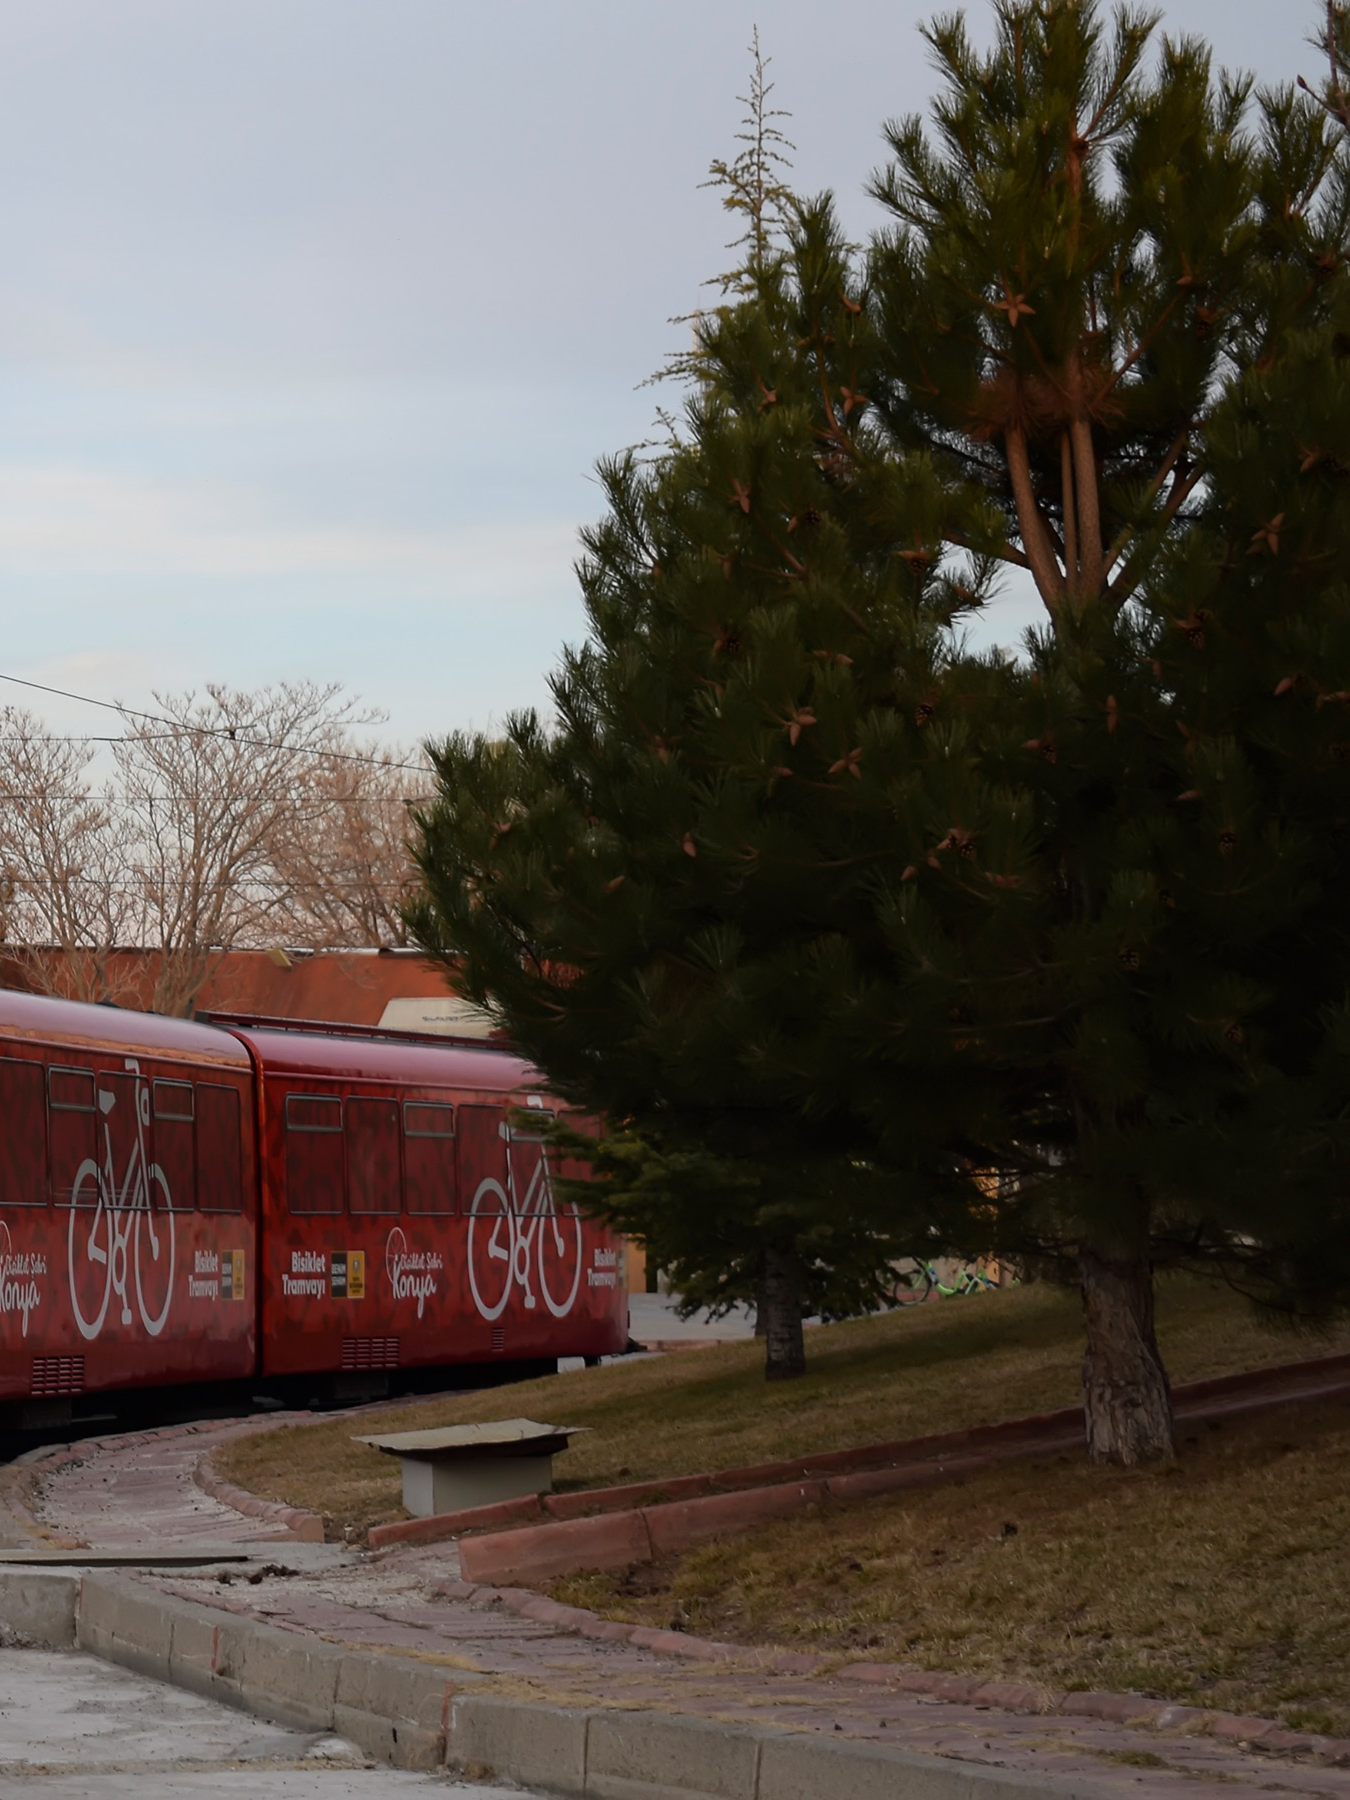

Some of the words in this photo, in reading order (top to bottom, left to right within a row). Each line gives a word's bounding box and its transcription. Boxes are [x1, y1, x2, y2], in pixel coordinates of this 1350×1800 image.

[195, 1250, 219, 1273] Bisiklet
[292, 1250, 326, 1273] Bisiklet
[281, 1273, 326, 1300] Tramvayı
[393, 1261, 437, 1319] Konya
